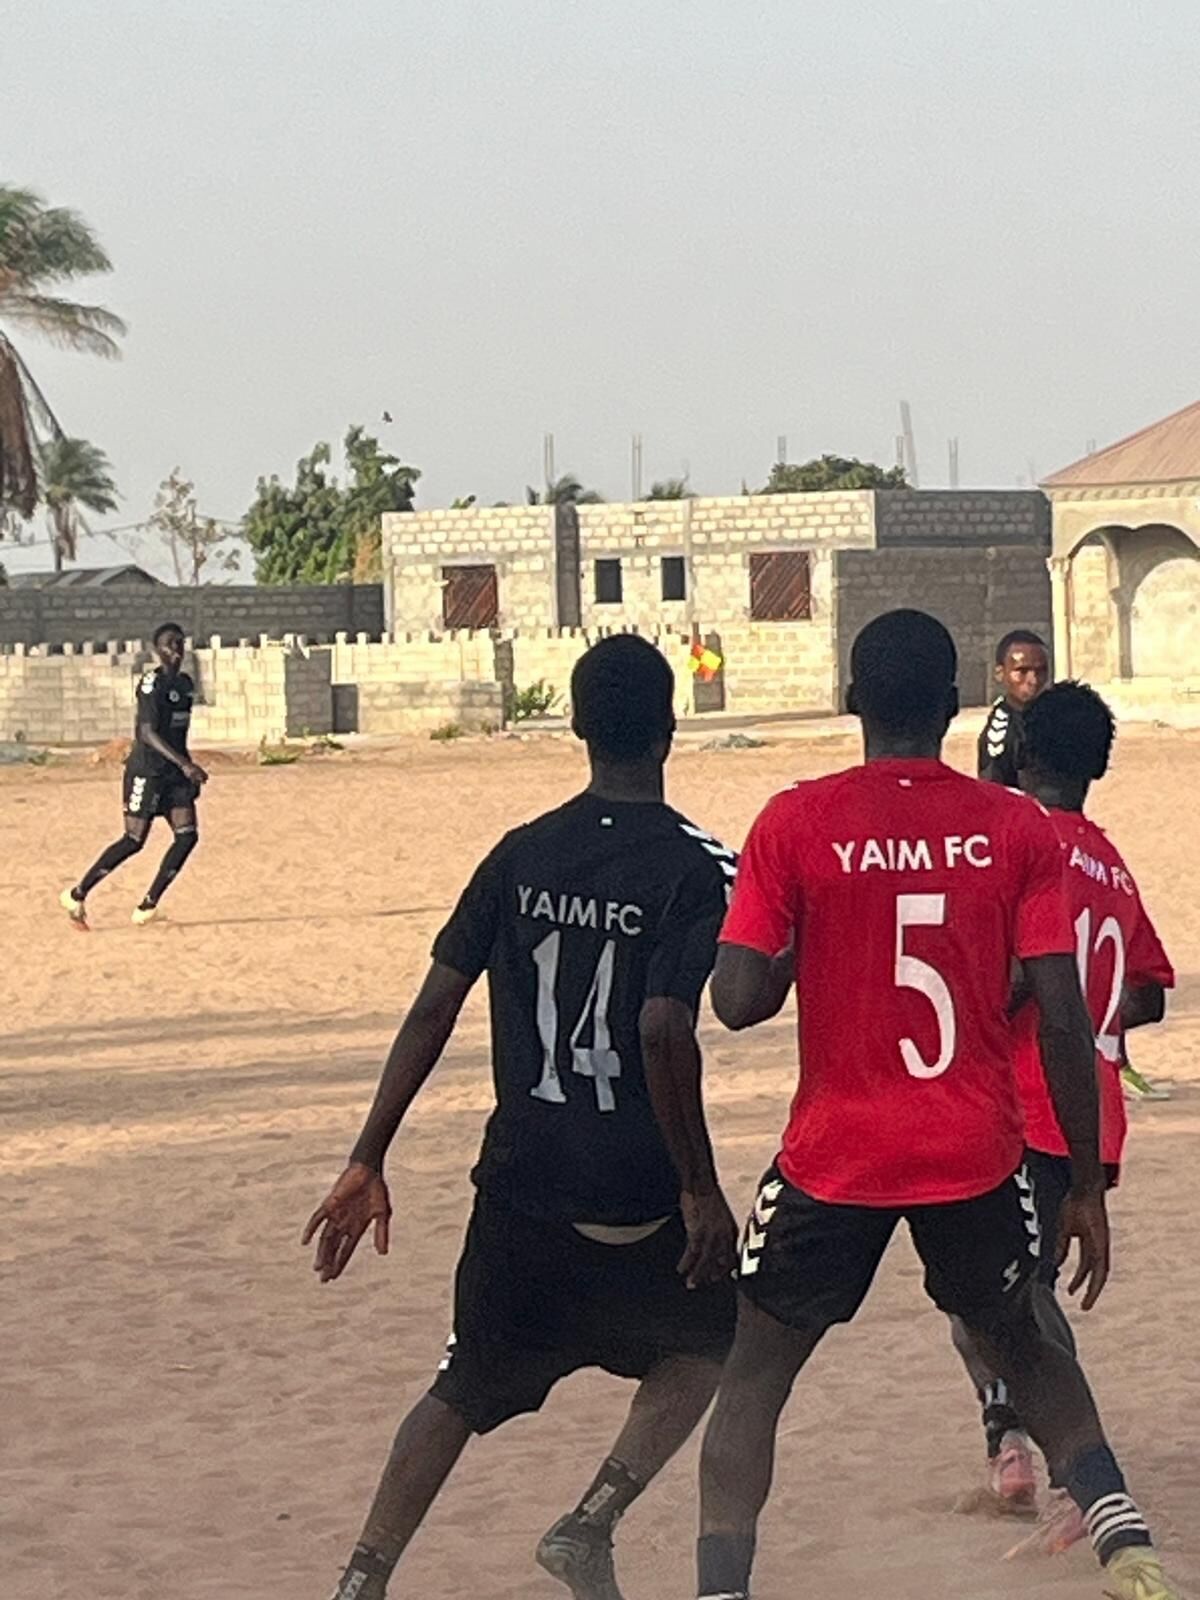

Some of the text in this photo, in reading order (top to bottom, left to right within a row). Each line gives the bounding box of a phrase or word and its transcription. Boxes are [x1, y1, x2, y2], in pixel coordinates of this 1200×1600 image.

[831, 834, 992, 873] YAIM FC
[1060, 842, 1134, 896] AIM FC
[516, 884, 643, 936] YAIM FC
[530, 929, 622, 1112] 14
[895, 893, 957, 1079] 5
[1074, 907, 1125, 1062] 12
